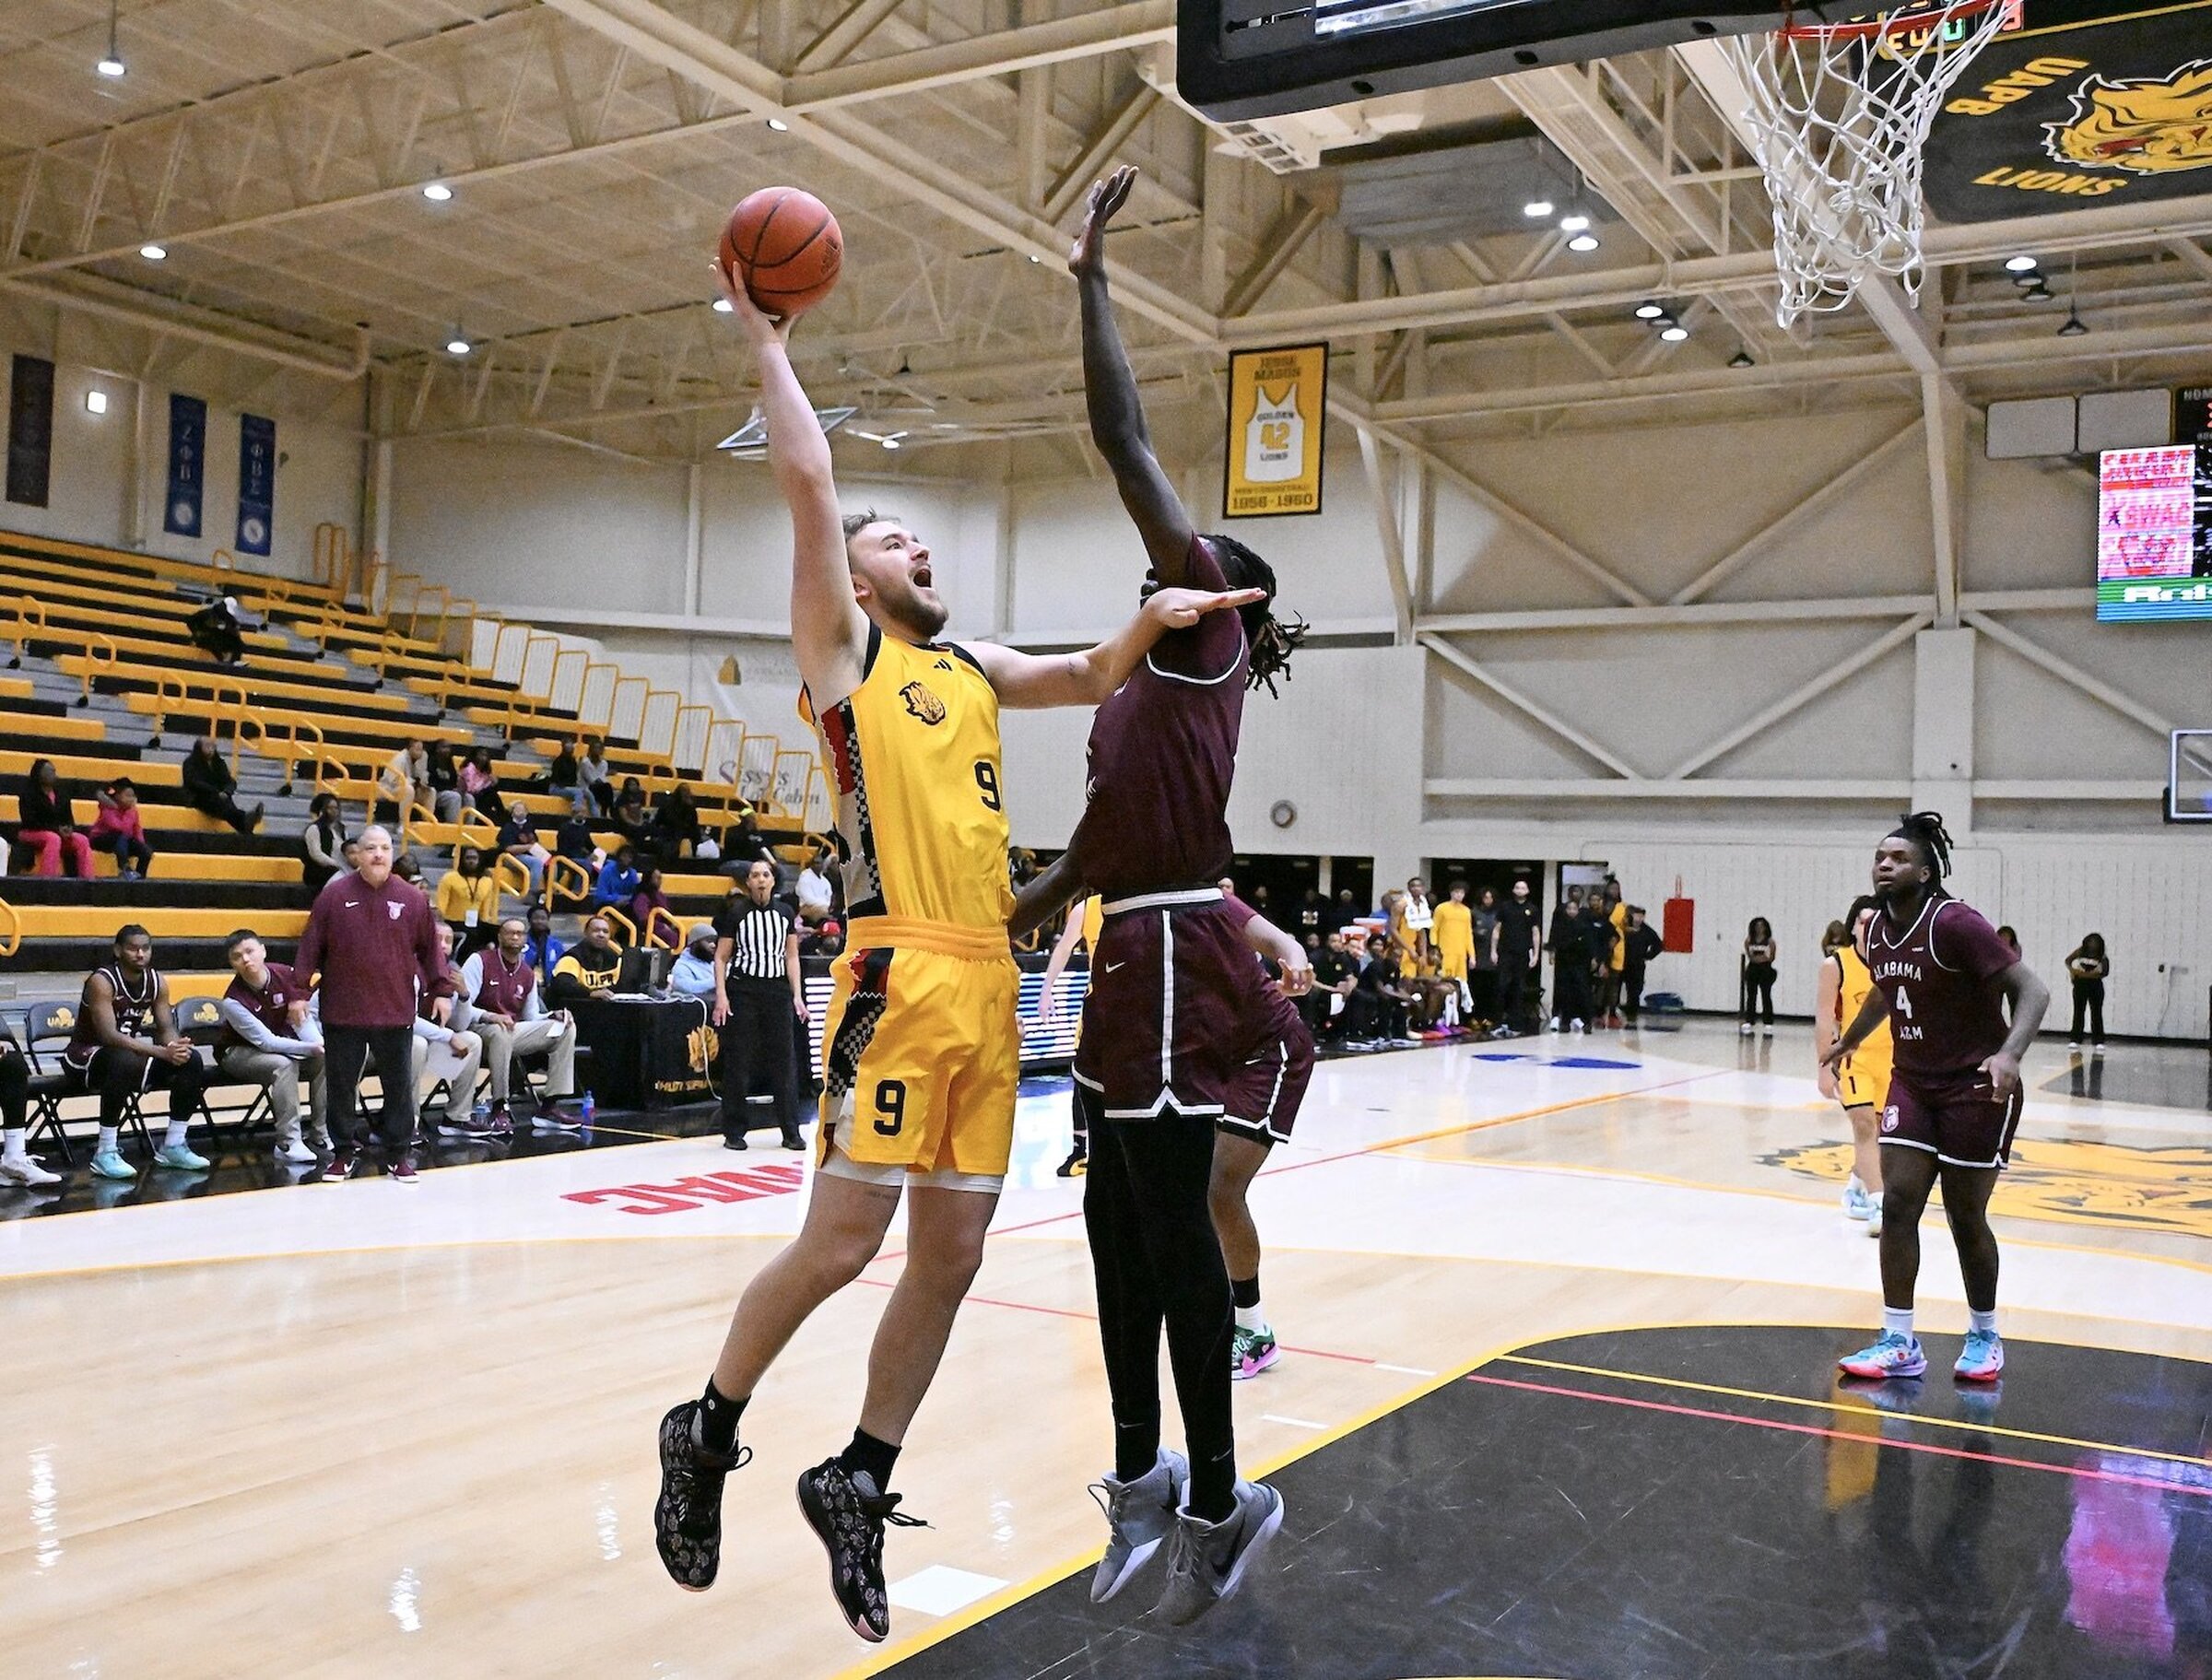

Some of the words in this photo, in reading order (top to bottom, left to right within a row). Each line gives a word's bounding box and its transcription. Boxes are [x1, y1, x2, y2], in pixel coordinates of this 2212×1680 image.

[1945, 57, 2090, 116] UAPB
[1971, 166, 2128, 195] LIONS
[2183, 388, 2212, 400] HOM
[1260, 422, 1290, 450] 42
[1259, 452, 1288, 462] LIONS
[974, 761, 1002, 812] 9
[1874, 961, 1923, 982] ALABAMA
[1896, 985, 1912, 1019] 4
[1900, 1025, 1924, 1040] A&M
[1848, 1075, 1856, 1095] 1
[873, 1079, 907, 1136] 9
[559, 1159, 804, 1216] WAC
